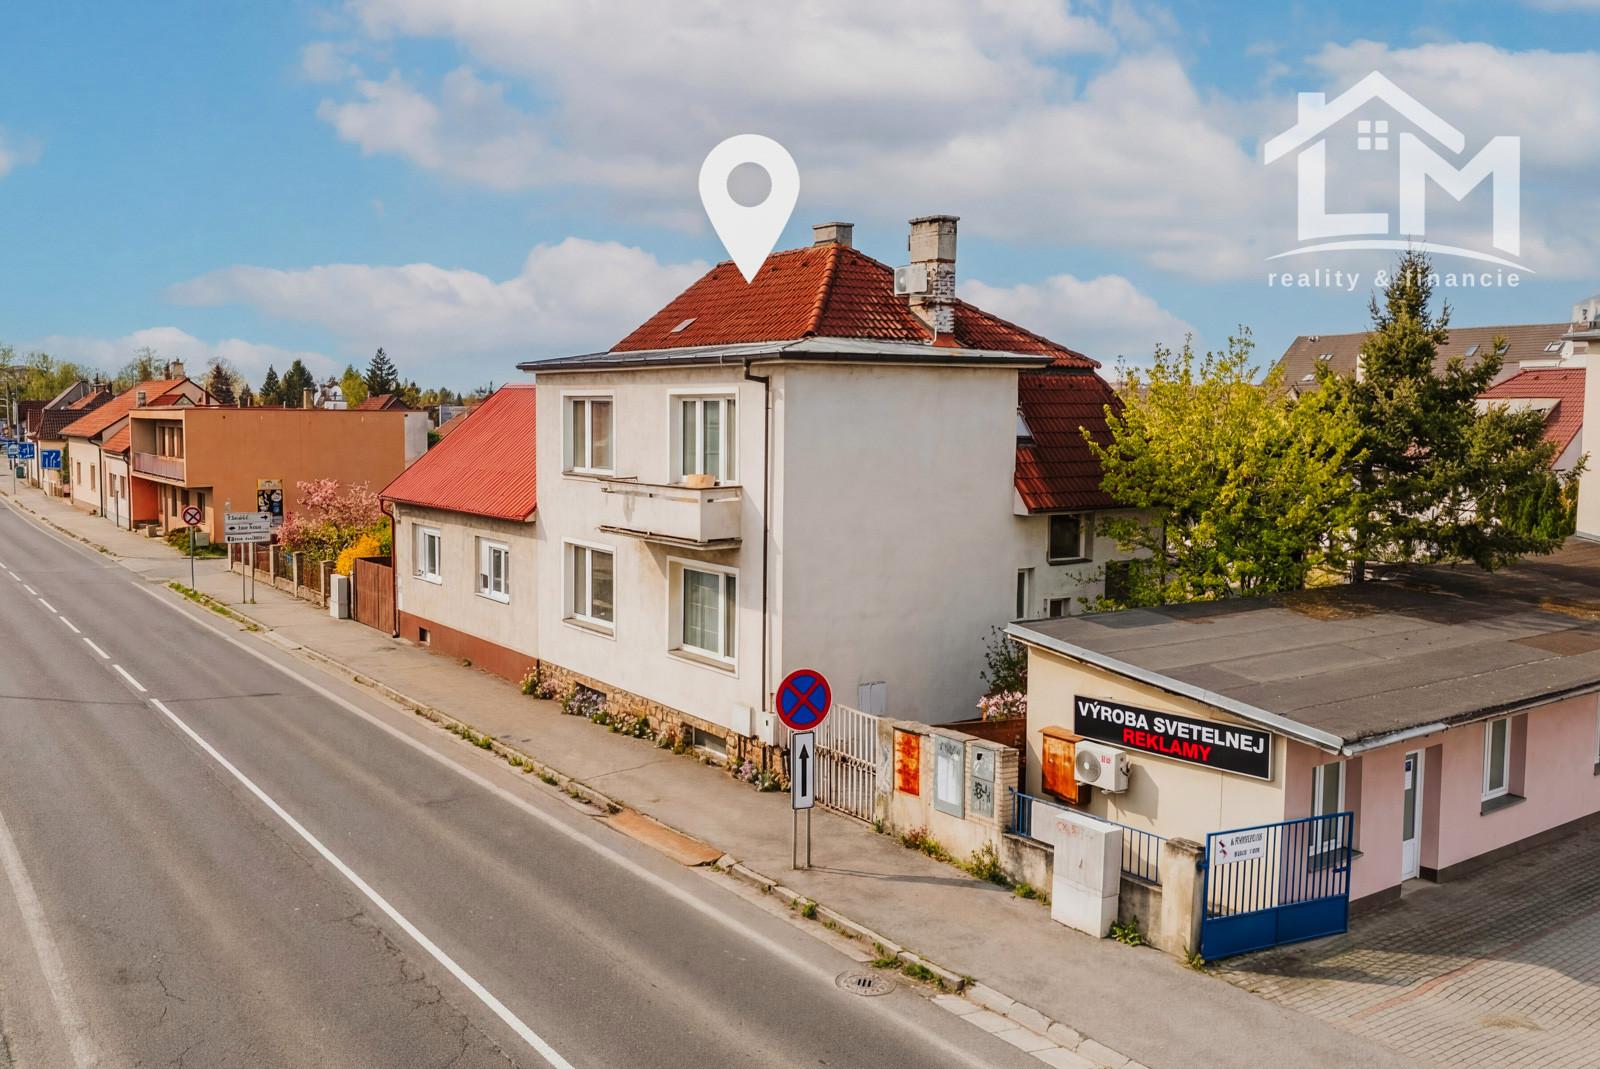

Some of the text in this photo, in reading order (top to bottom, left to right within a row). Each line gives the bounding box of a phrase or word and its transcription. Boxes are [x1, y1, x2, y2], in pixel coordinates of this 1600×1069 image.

[1078, 700, 1265, 754] VÝROBA SVETELNEJ
[1122, 728, 1211, 762] REKLAMY
